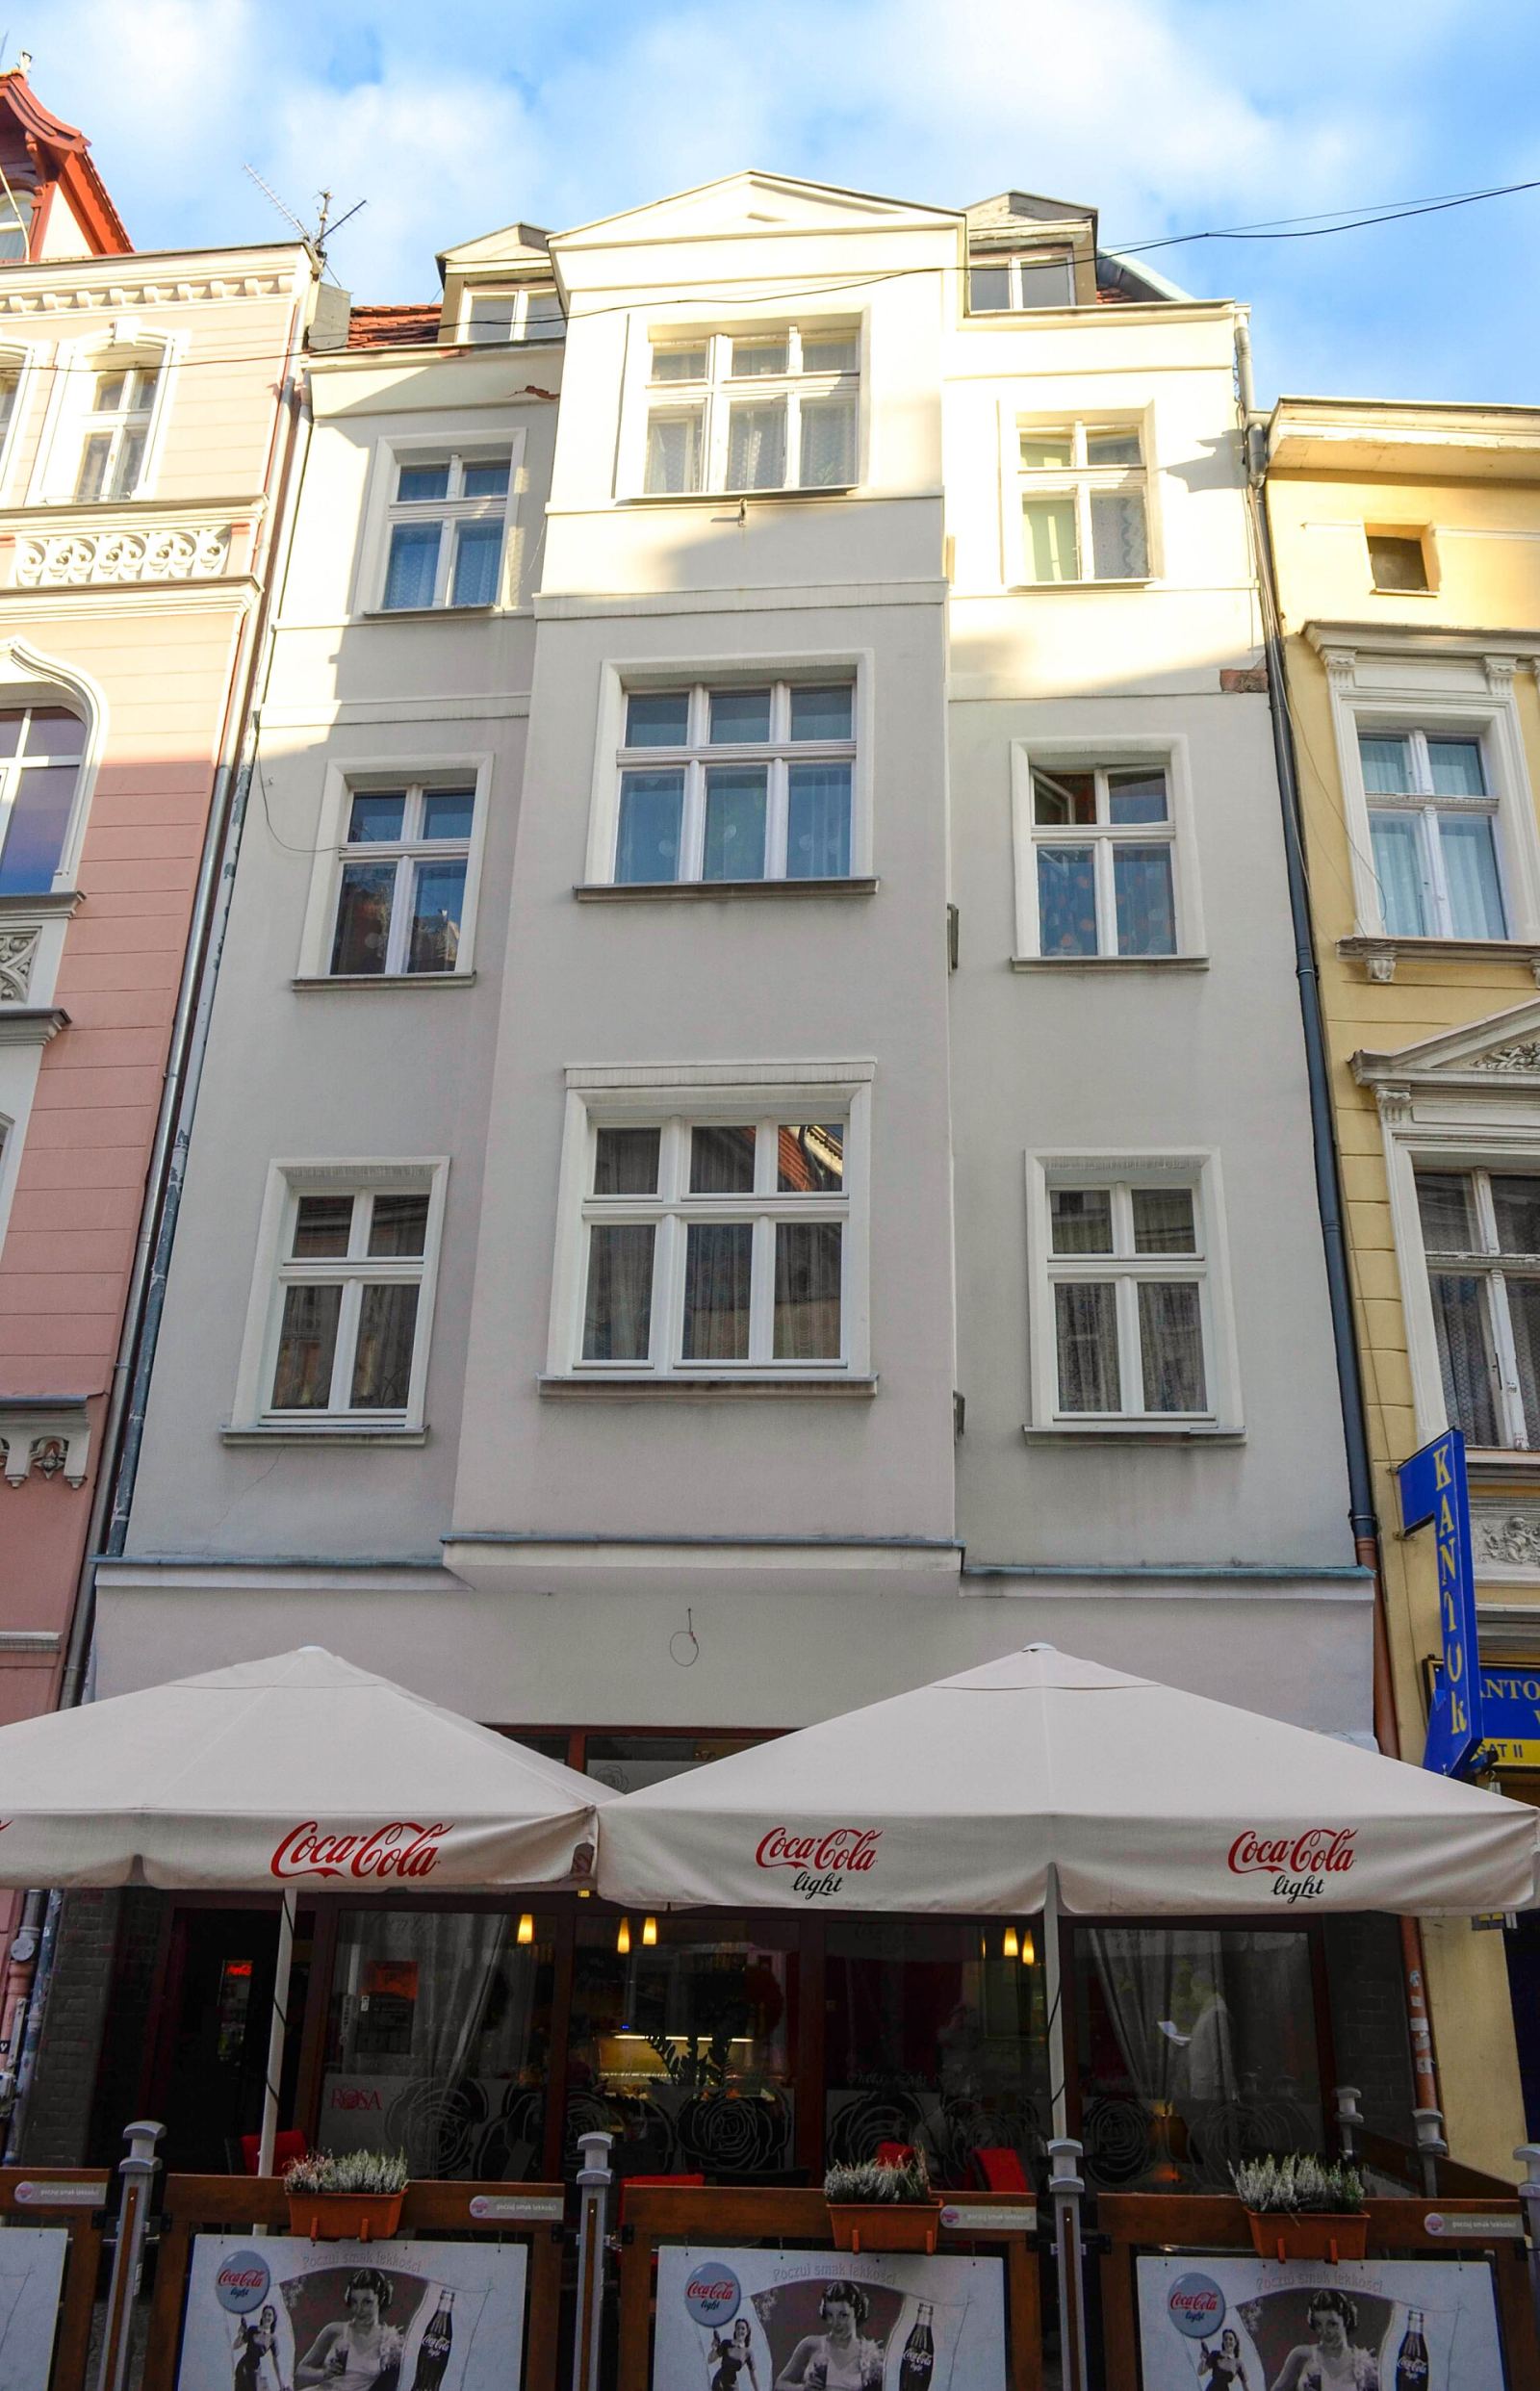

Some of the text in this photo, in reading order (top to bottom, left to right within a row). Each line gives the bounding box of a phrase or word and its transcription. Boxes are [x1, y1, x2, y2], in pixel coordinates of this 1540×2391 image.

[270, 1820, 455, 1878] Coca-Cola
[755, 1827, 884, 1871] Coca-Cola
[1227, 1829, 1359, 1874] Coca-Cola
[790, 1871, 843, 1900] light
[1270, 1875, 1324, 1904] light
